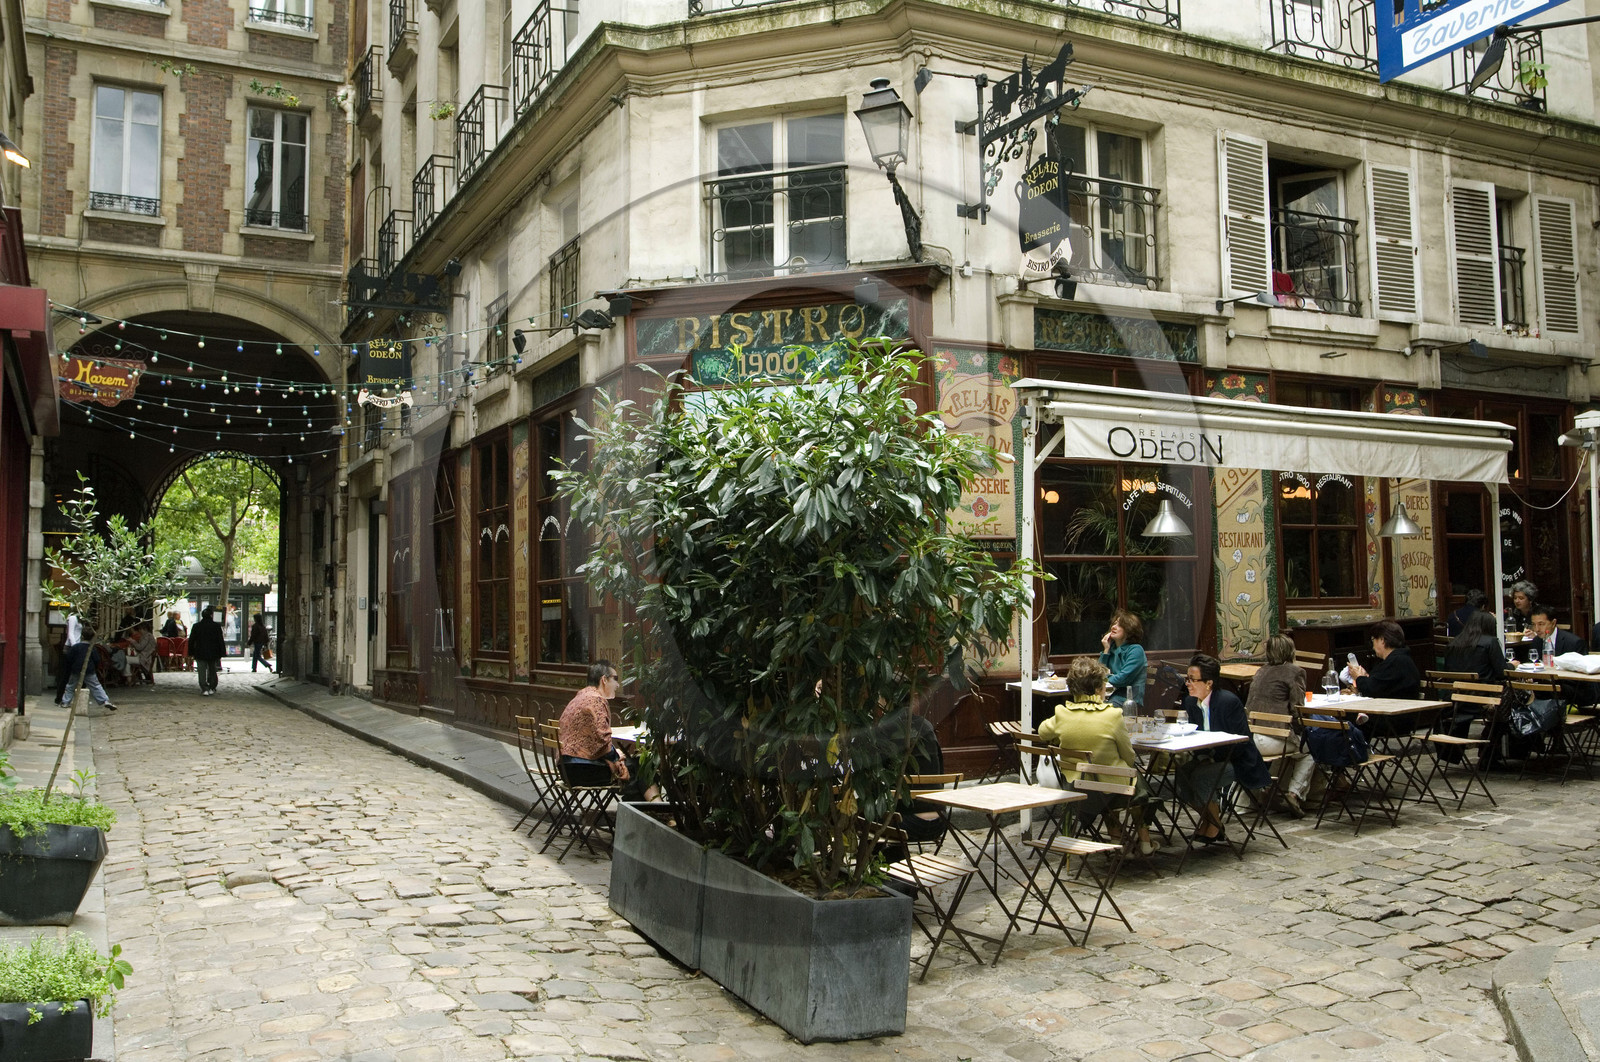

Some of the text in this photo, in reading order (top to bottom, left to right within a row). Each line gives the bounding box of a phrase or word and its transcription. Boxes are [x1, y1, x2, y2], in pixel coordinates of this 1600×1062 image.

[1025, 161, 1059, 186] RELAIS
[1027, 177, 1059, 200] ODEON
[1024, 222, 1061, 244] Brasserie
[1026, 259, 1050, 272] BISTRO
[674, 304, 866, 351] BISTRO
[1039, 317, 1189, 354] RESTAURANT
[369, 350, 402, 359] ODEON
[739, 352, 799, 377] 1900
[75, 360, 129, 388] Harem
[366, 375, 405, 385] Brasseie
[944, 390, 1011, 418] RELAIS
[1138, 428, 1195, 440] RELAIS
[1107, 426, 1224, 464] ODEON
[1296, 472, 1311, 489] 1900
[1315, 472, 1354, 491] RESTAURANT
[1122, 489, 1140, 511] CAFE
[1157, 481, 1193, 509] SPIRITUEUX
[1405, 495, 1429, 510] BIERES
[1219, 532, 1264, 549] RESTAURANT
[1503, 538, 1513, 547] DE
[1400, 551, 1434, 571] BRASSERIE
[1409, 575, 1429, 589] 1900
